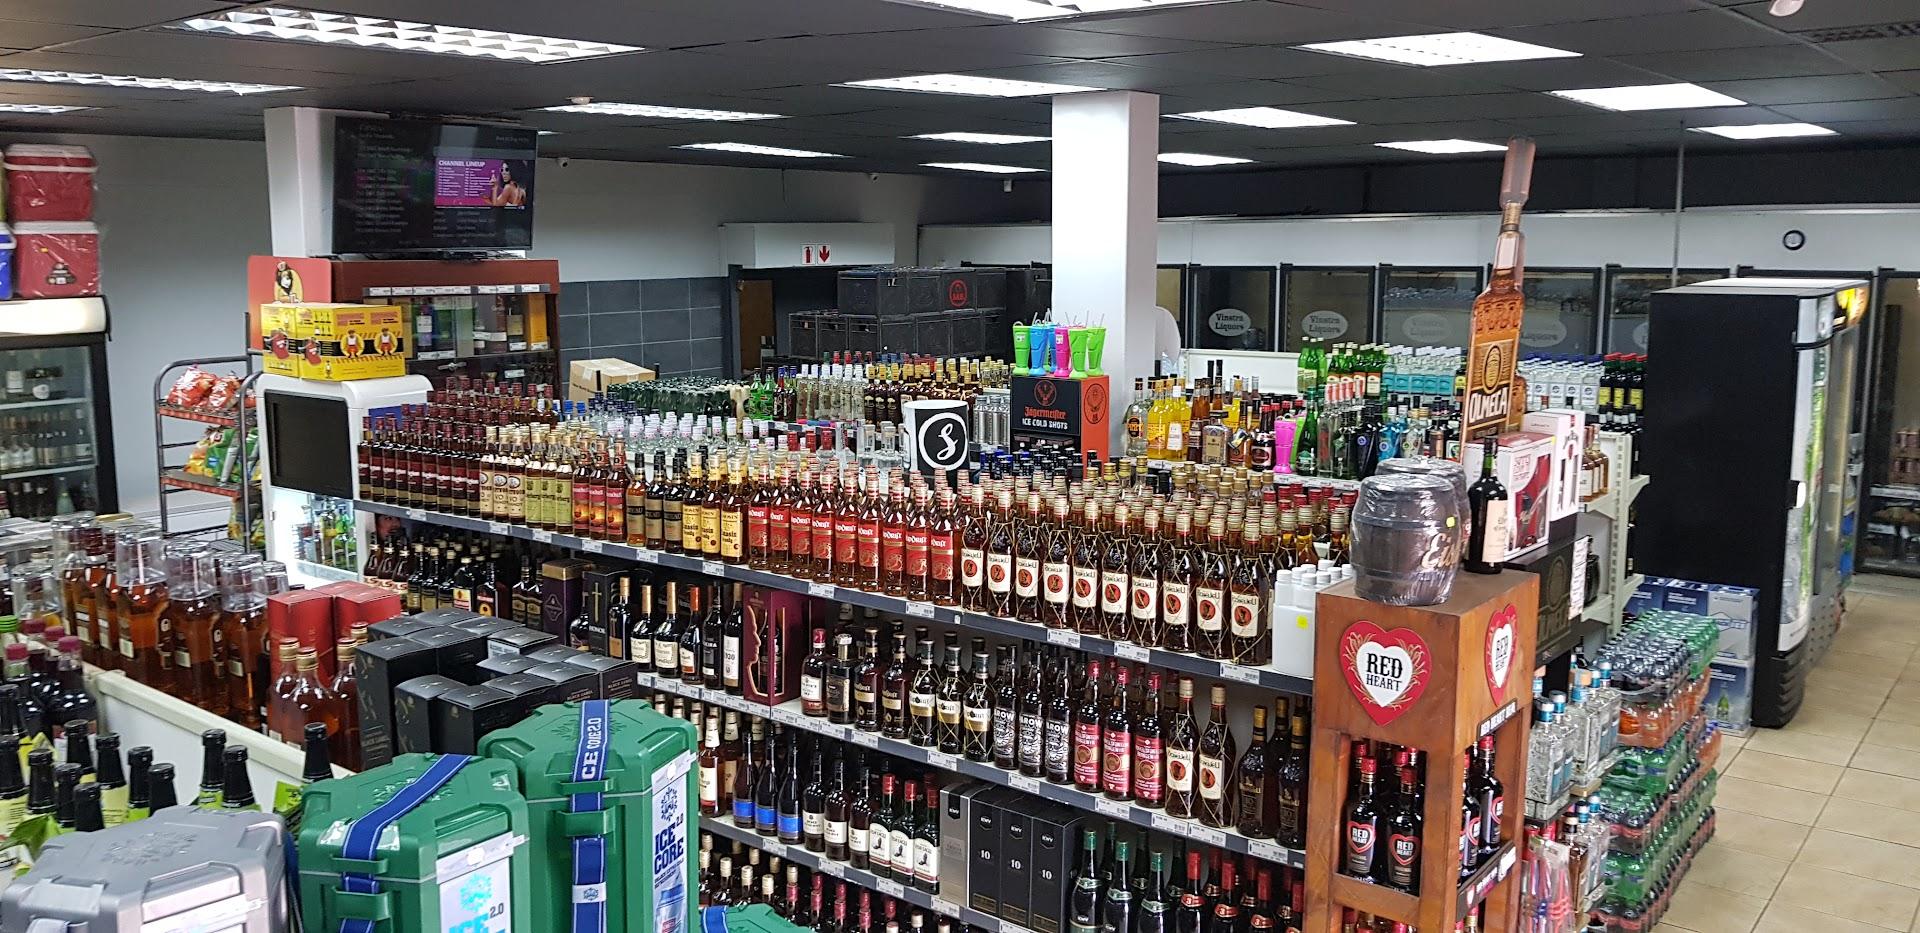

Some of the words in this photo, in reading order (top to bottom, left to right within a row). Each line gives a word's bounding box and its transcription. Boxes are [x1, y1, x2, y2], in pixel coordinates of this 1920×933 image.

[439, 159, 465, 167] CHANNEL
[1215, 322, 1244, 332] Liquors
[1469, 386, 1508, 424] OLMECA
[1022, 418, 1031, 426] ICE
[1032, 419, 1047, 428] COLD
[1048, 420, 1068, 430] SHOTS
[1366, 653, 1403, 680] RED
[1366, 673, 1402, 692] HEART
[582, 751, 599, 780] CE
[980, 816, 992, 824] KWV
[1010, 825, 1022, 833] KWV
[1352, 827, 1369, 839] RED
[655, 822, 676, 855] ICE
[1042, 835, 1054, 843] KWV
[1396, 840, 1414, 851] RED
[655, 837, 684, 875] CORE
[981, 849, 991, 860] 10
[1011, 859, 1021, 870] 10
[1042, 869, 1052, 880] 10
[490, 903, 504, 918] 2.0
